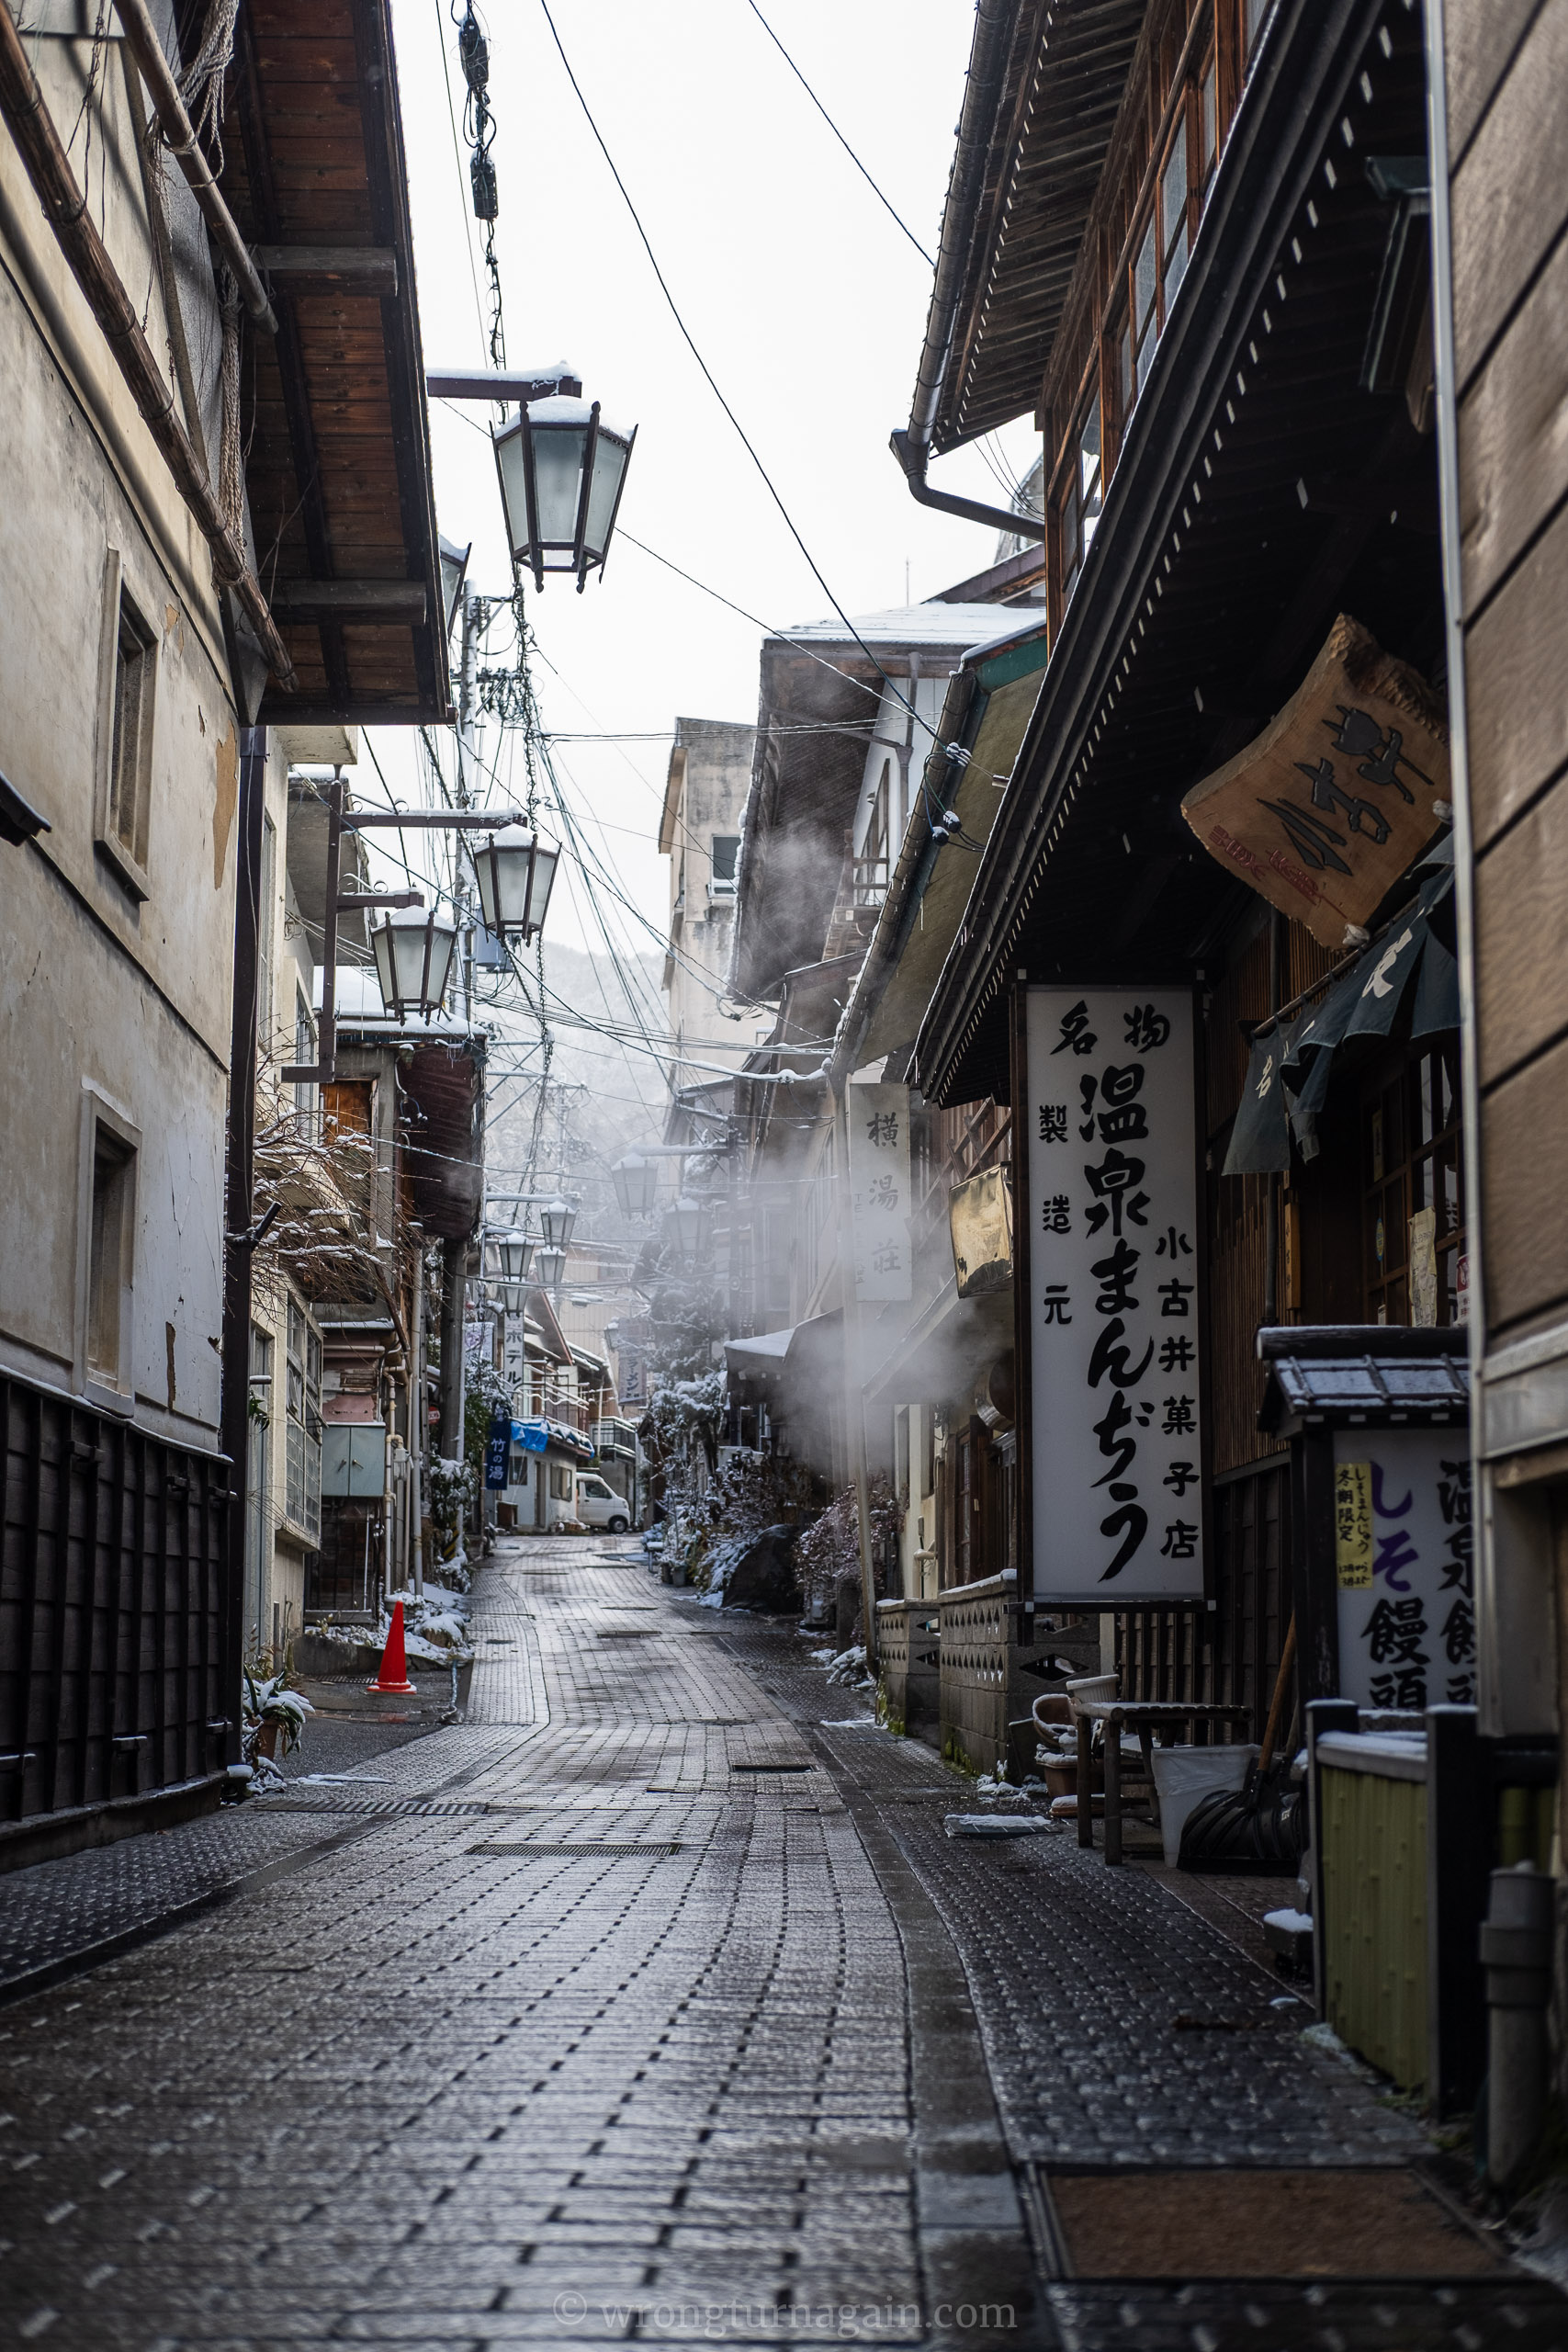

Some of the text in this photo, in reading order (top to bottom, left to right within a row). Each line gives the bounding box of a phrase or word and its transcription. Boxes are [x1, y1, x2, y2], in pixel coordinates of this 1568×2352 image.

[1049, 1000, 1170, 1056] 名物
[866, 1112, 901, 1274] 横湯荘
[1039, 1104, 1073, 1325] 製造元
[1078, 1063, 1156, 1583] 温泉まんぢう
[1156, 1226, 1201, 1559] 小古井菓子店
[489, 1438, 506, 1480] 竹の湯
[1337, 1469, 1355, 1543] 冬期限定
